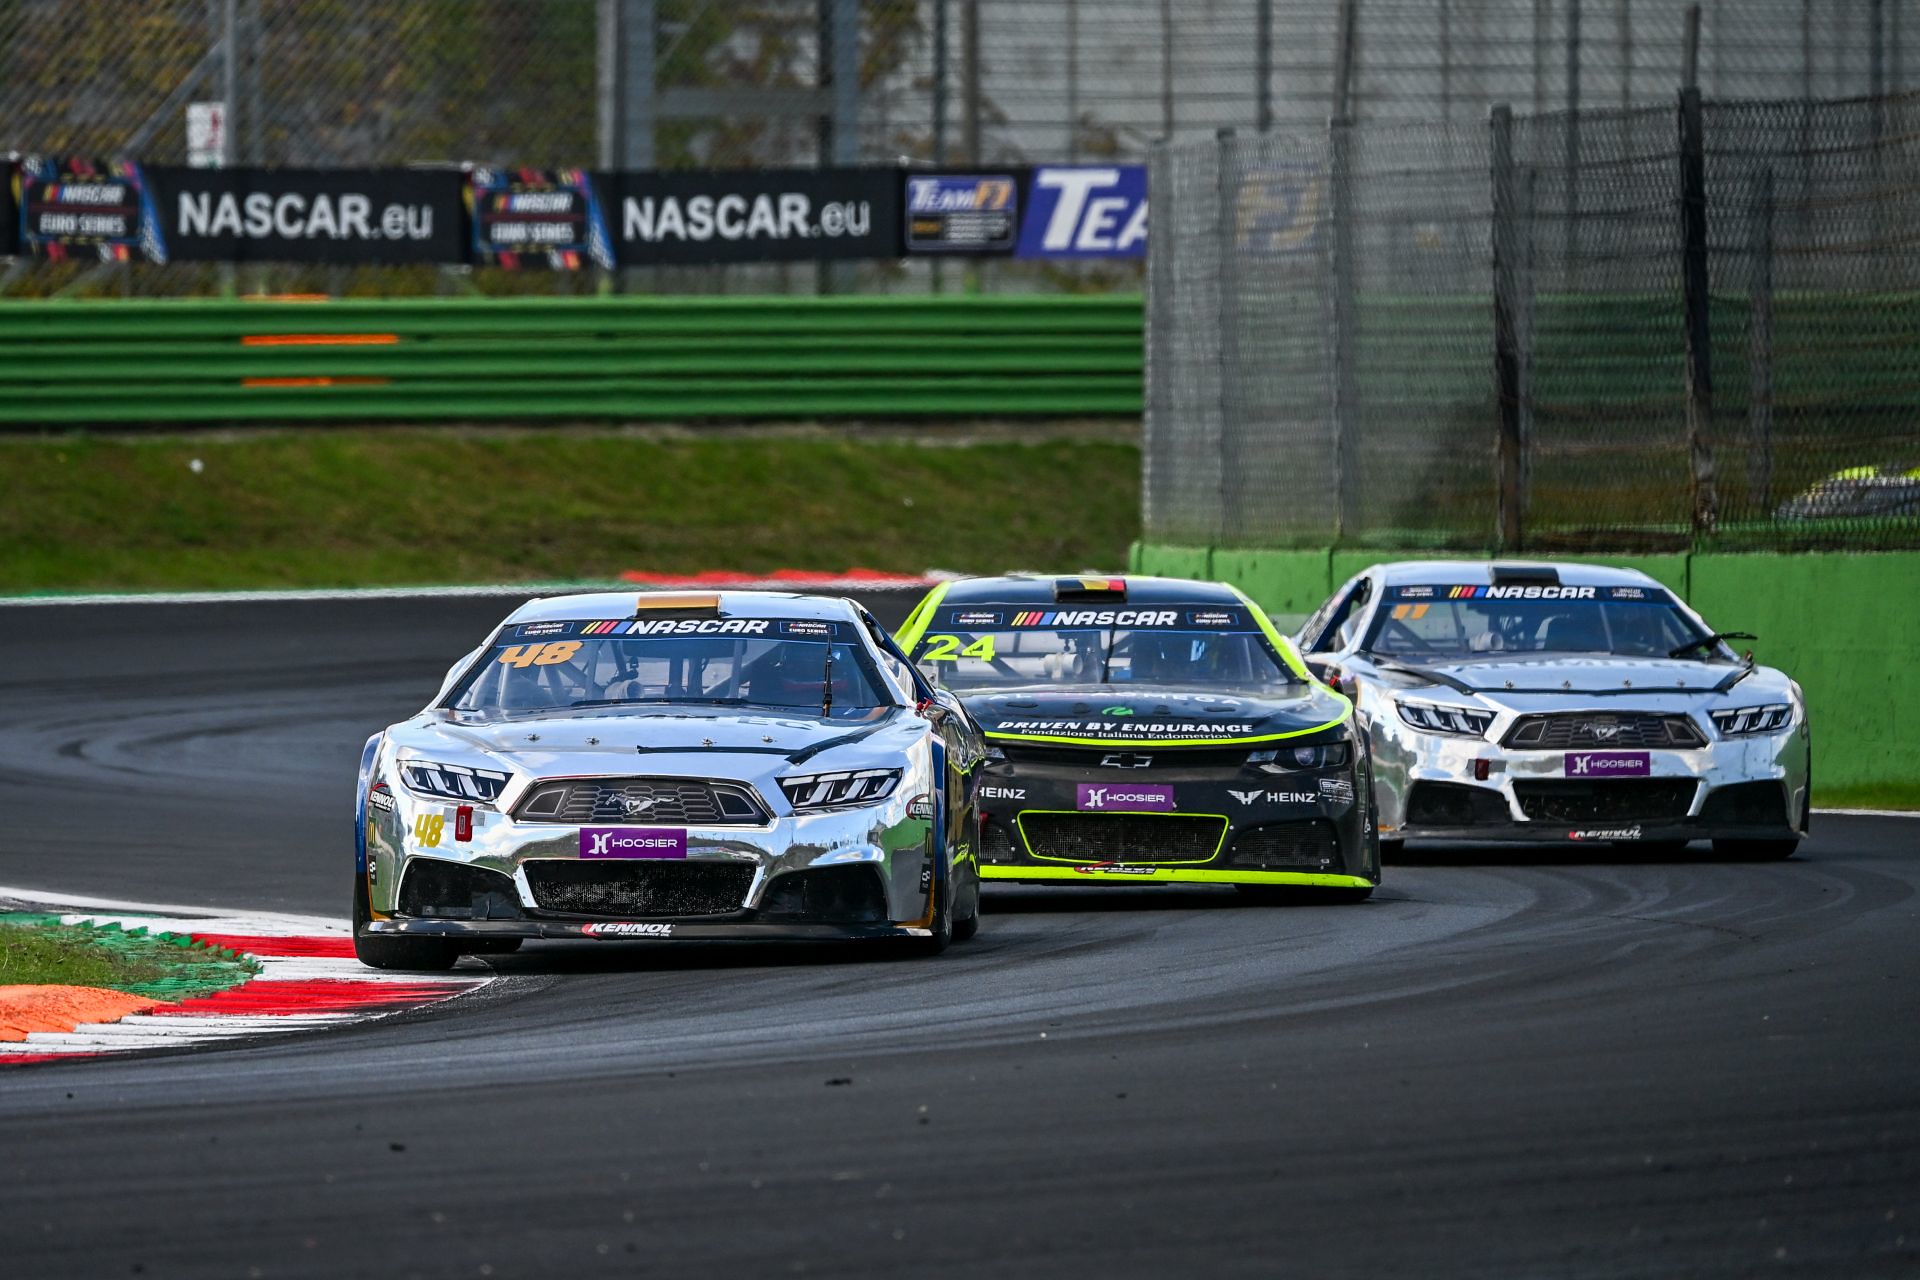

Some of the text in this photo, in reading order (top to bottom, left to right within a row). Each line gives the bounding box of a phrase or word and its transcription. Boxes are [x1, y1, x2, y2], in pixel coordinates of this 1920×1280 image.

[178, 191, 433, 239] NASCAR.eu
[623, 193, 870, 241] NASCAR.eu
[1485, 586, 1595, 598] NASCAR
[1052, 611, 1178, 625] NASCAR
[626, 620, 769, 634] NASCAR
[923, 634, 996, 662] 24
[498, 641, 584, 668] 48
[997, 721, 1254, 733] DRIVEN BY ENDURANCE
[1021, 729, 1095, 738] Fondazione
[1098, 731, 1145, 739] Italiana
[1591, 760, 1644, 769] HOOSIER
[1107, 793, 1165, 803] HOOSIER
[1267, 792, 1316, 803] HEINZ
[414, 814, 445, 848] 48
[612, 838, 678, 848] HOOSIER
[588, 923, 672, 933] KENNOL
